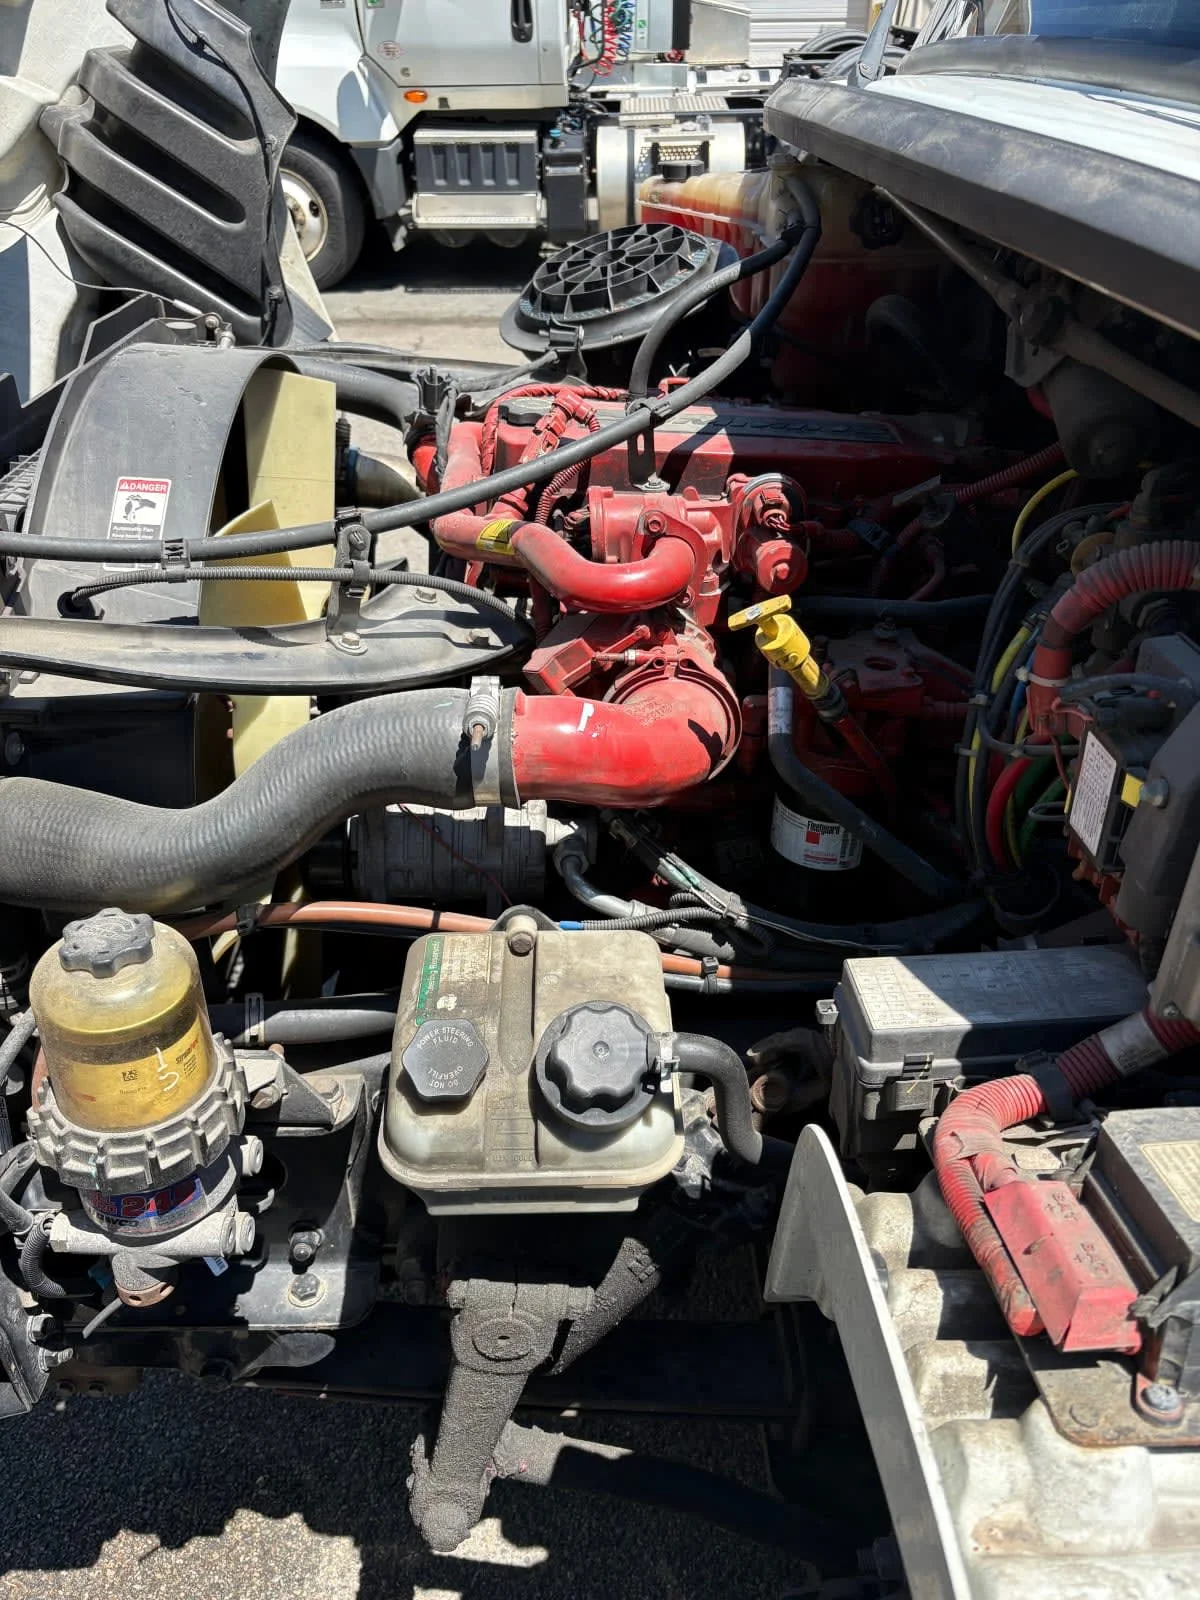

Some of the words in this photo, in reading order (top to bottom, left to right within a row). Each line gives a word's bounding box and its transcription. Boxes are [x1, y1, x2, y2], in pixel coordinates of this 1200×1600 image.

[129, 483, 167, 492] DANGER
[417, 1028, 440, 1049] POWER
[442, 1027, 474, 1047] STEERING
[432, 1035, 458, 1045] FLUID
[427, 1065, 463, 1080] OVERFILL
[429, 1080, 445, 1088] NOT
[447, 1079, 459, 1088] DO
